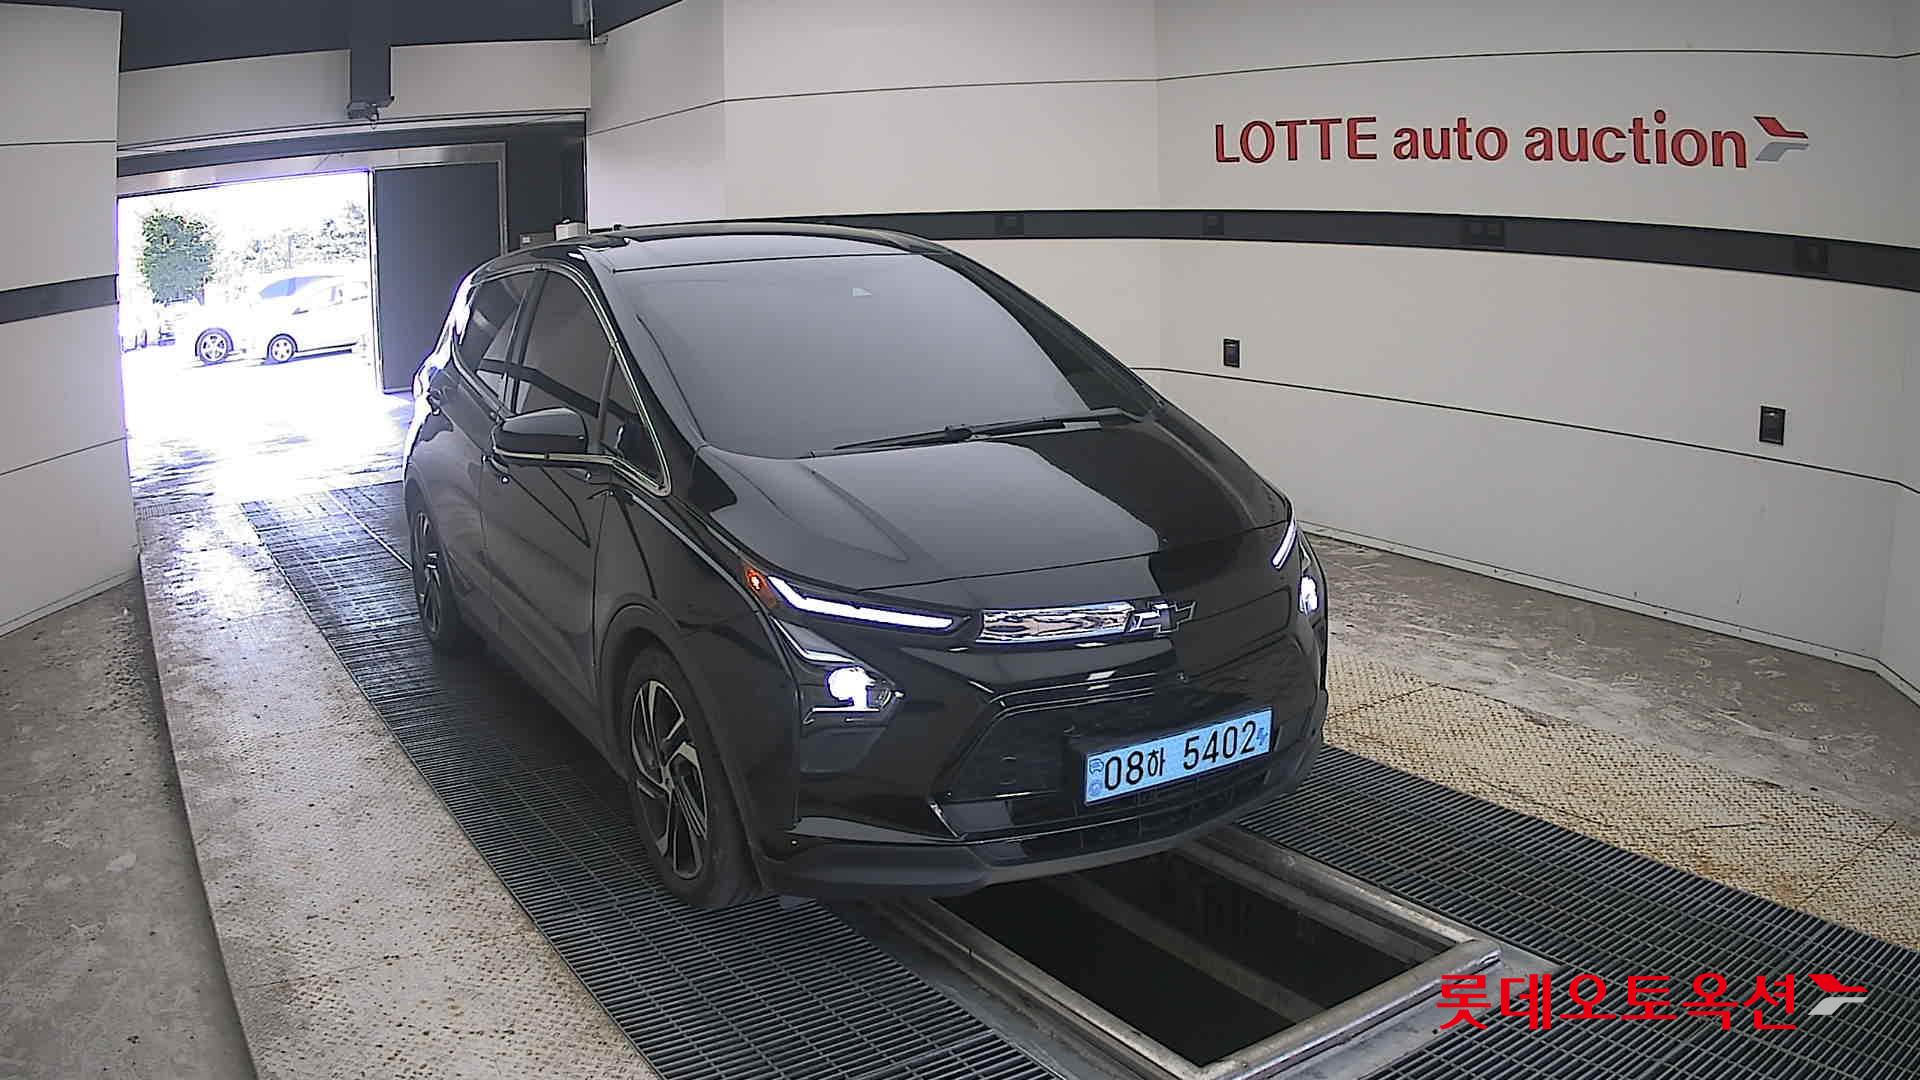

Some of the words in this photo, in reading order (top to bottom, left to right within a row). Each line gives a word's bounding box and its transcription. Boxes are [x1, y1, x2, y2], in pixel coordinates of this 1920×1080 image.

[1215, 116, 1377, 163] LOTTE
[1393, 117, 1509, 161] auto
[1524, 110, 1748, 168] auction
[1104, 747, 1166, 790] 08하
[1183, 720, 1257, 770] 5402
